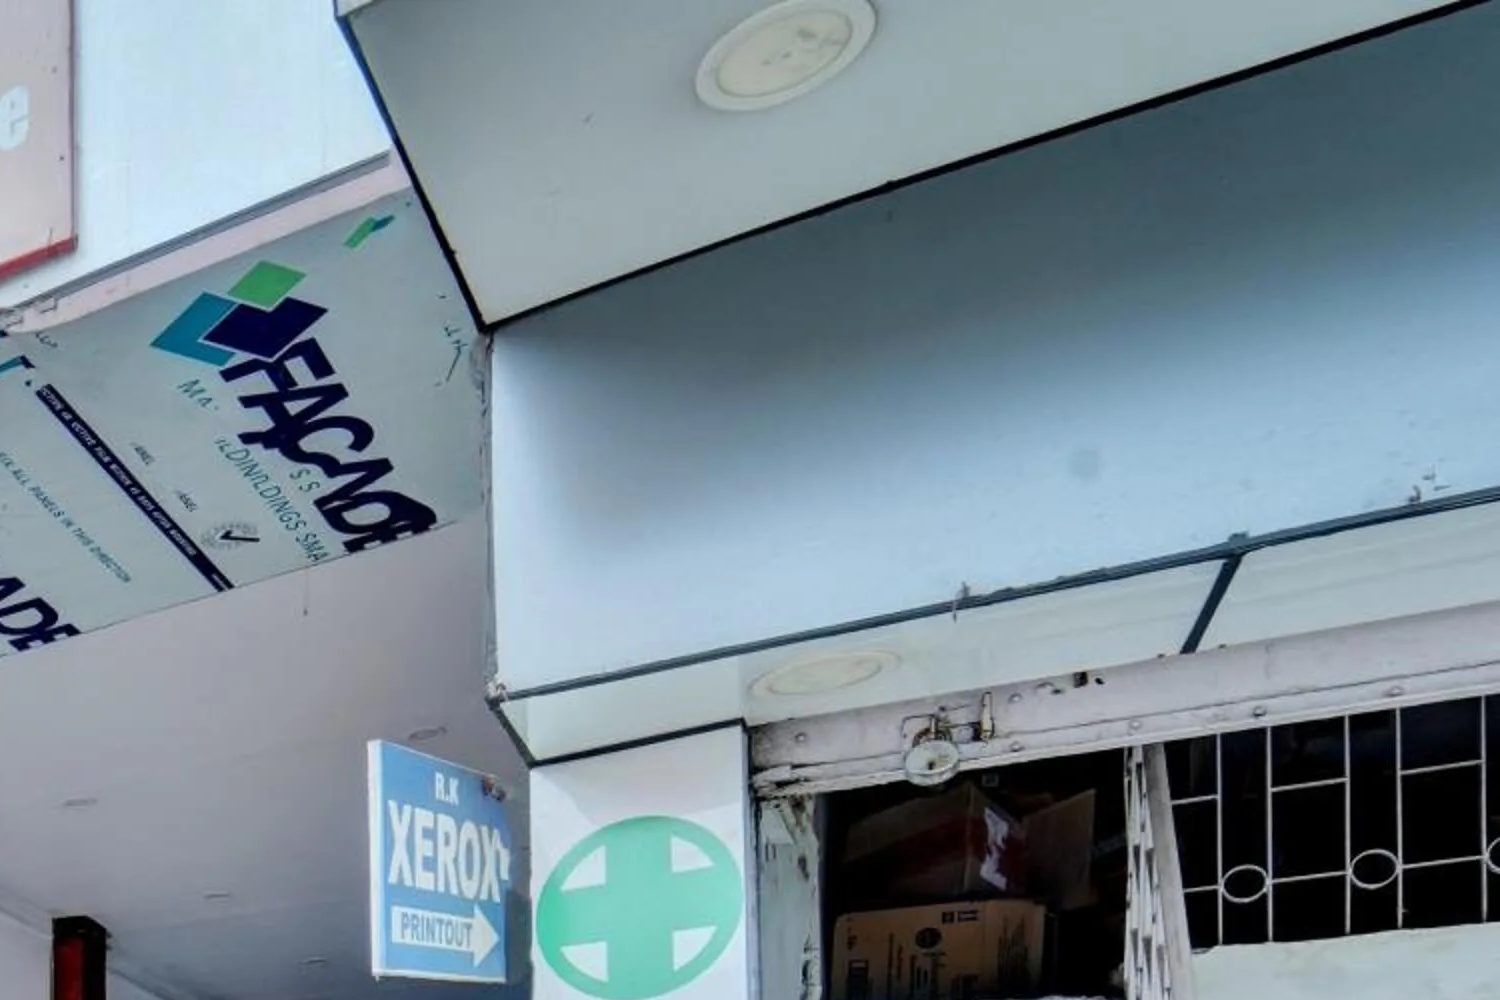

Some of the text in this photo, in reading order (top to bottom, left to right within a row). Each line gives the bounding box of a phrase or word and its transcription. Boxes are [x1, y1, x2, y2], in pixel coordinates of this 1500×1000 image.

[435, 772, 459, 805] R.K
[387, 800, 510, 903] XEROX
[401, 912, 473, 948] PRINTOUT
